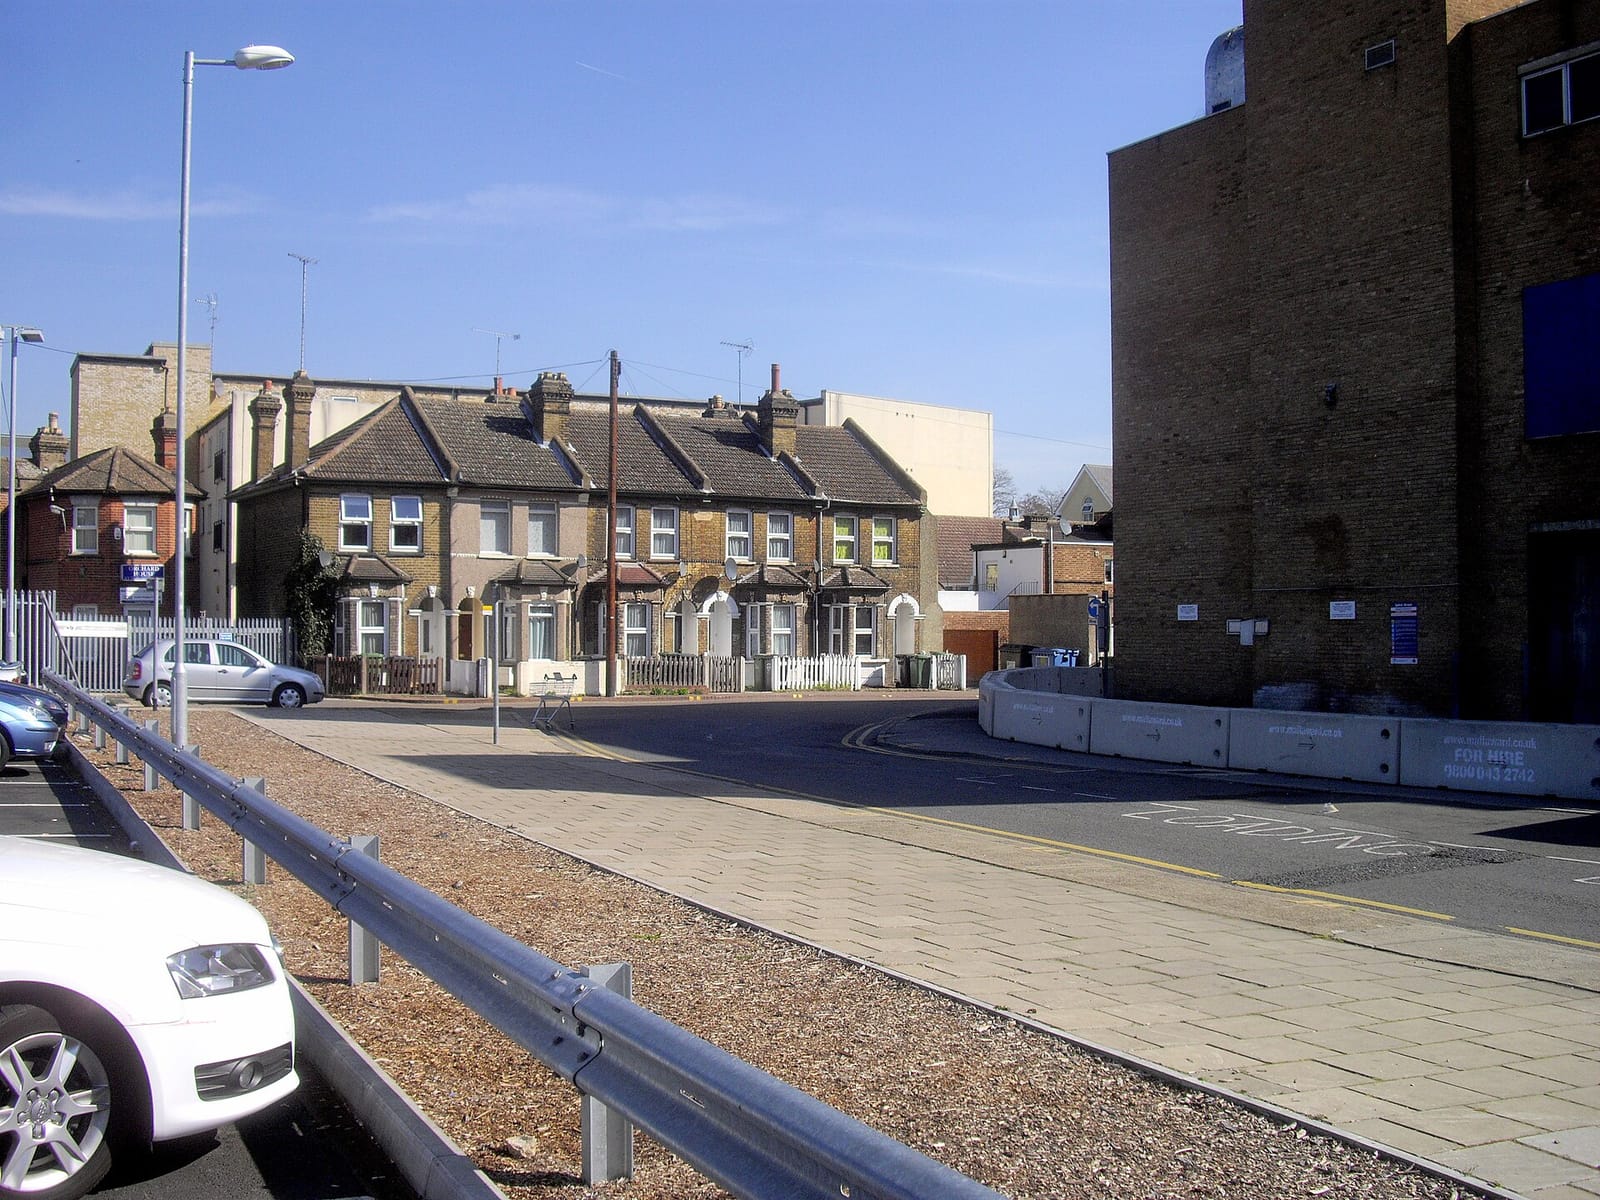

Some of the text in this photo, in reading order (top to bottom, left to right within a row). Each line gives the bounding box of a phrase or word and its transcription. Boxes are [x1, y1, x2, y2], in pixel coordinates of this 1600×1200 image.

[1454, 747, 1524, 766] FOR HIRE
[1503, 768, 1536, 783] 2742
[1121, 809, 1435, 856] LOADING
